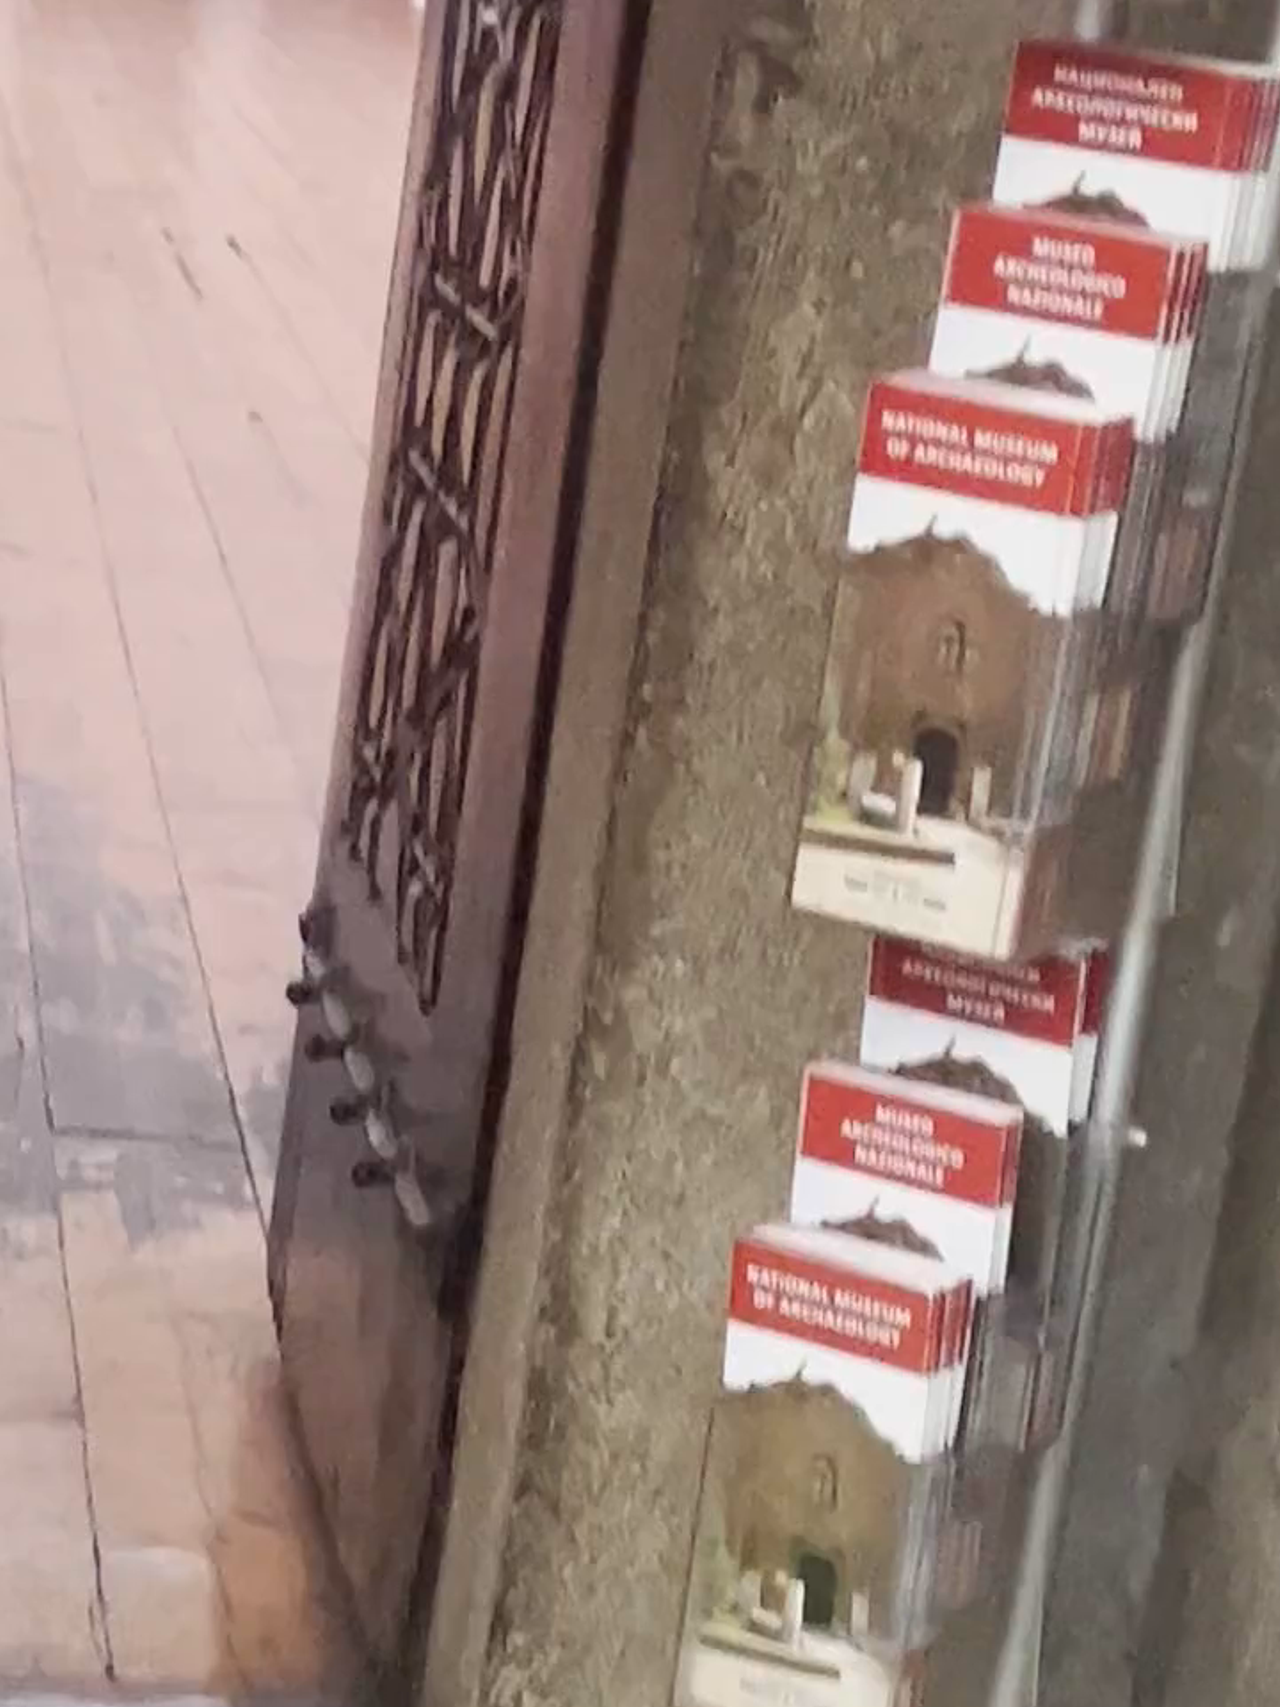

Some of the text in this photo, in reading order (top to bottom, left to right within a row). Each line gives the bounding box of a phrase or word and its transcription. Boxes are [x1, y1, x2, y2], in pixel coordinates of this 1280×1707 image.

[1054, 62, 1183, 101] НАЦИОНАЛЕН
[1032, 86, 1198, 133] АРХЕОЛОГИЧЕСКИ
[1078, 119, 1142, 150] МУЗЕЙ
[1032, 236, 1095, 269] MUSEO
[993, 254, 1126, 299] ARCHEOLOGICO
[1007, 283, 1103, 320] NAZIONALE
[882, 410, 1058, 465] NATIONAL MUSEUM
[886, 437, 1045, 488] OF ARCHAEOLOGY
[946, 993, 1005, 1025] МУЗЕЙ
[876, 1102, 934, 1136] MUSEO
[841, 1117, 964, 1170] ARCHEOLOGICO
[855, 1143, 945, 1188] NAZIONALE
[747, 1263, 911, 1330] NATIONAL MUSEUM
[754, 1289, 900, 1350] OF ARCHAEOLOGY
